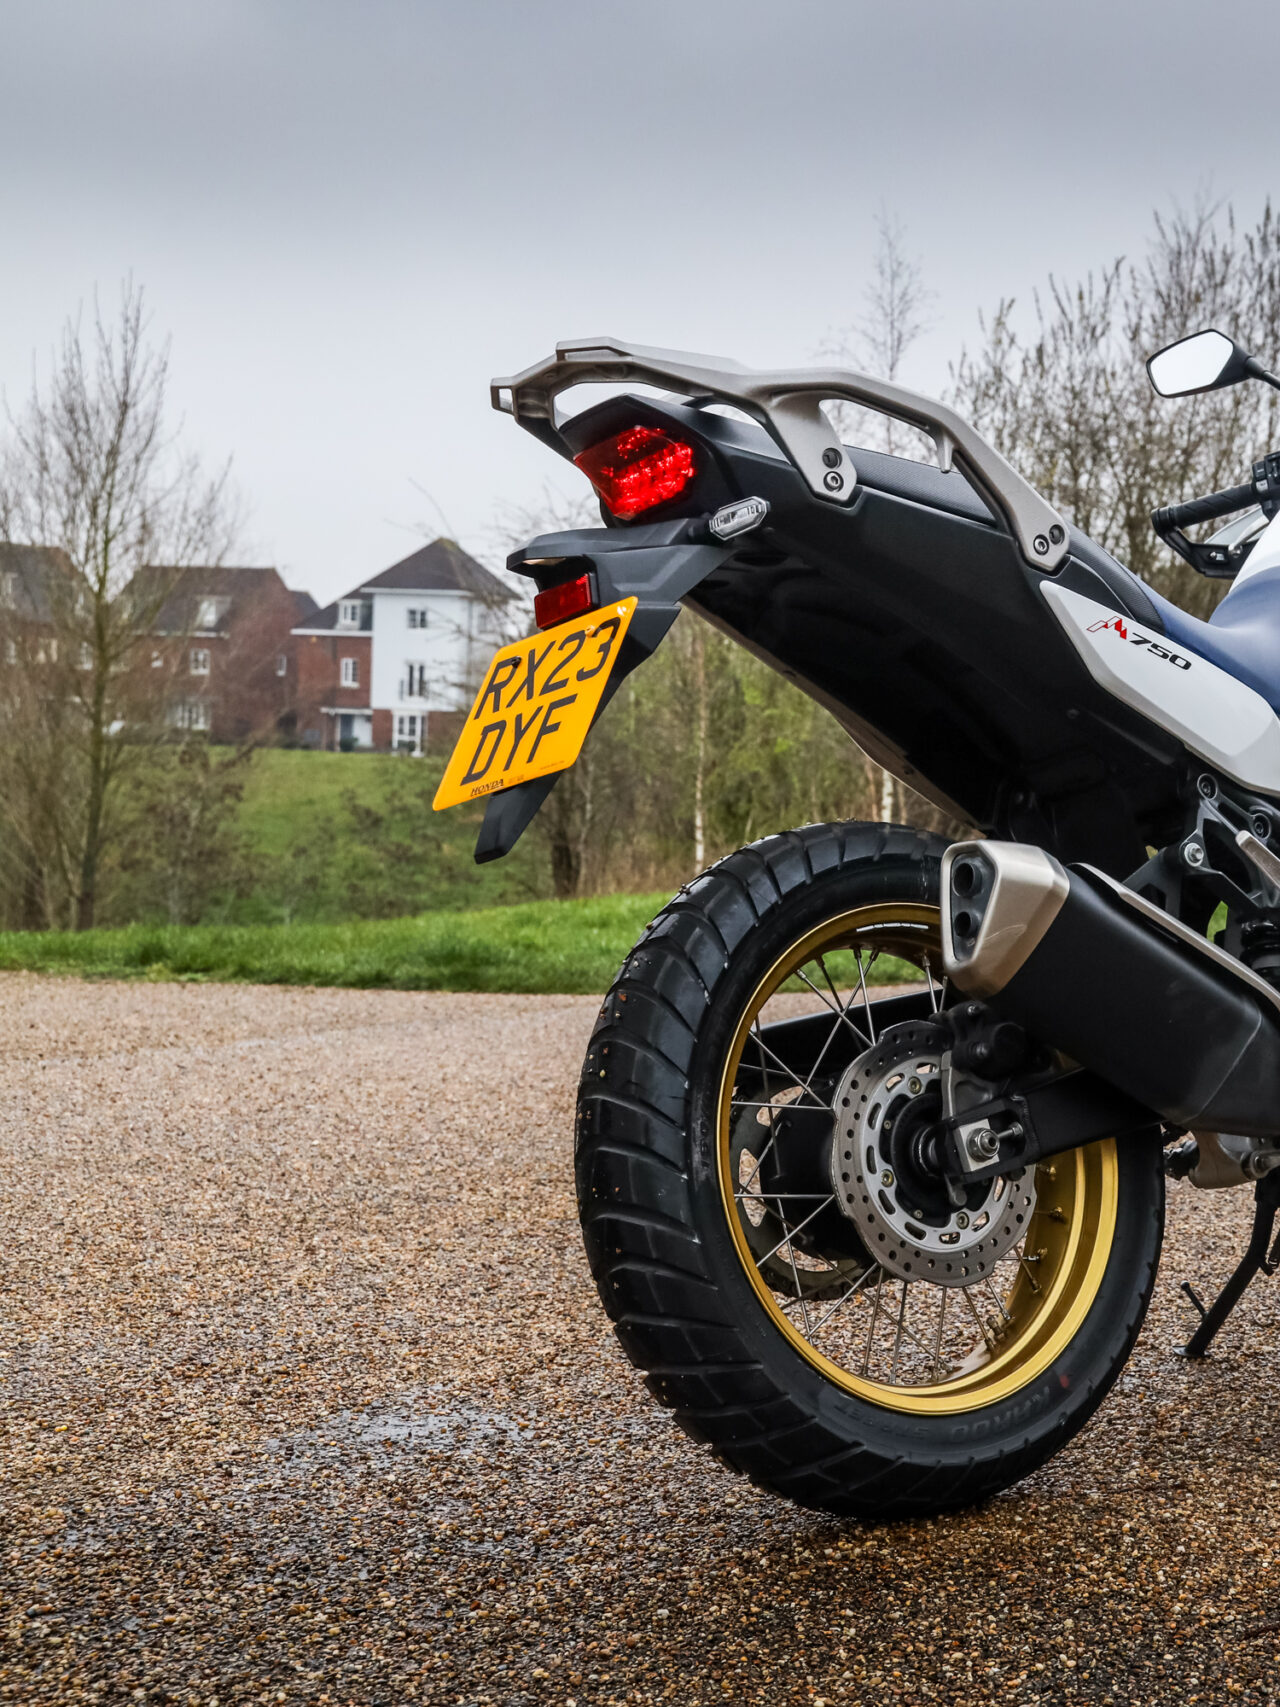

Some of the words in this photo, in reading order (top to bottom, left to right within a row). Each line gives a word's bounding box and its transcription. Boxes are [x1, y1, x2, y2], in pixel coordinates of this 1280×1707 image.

[474, 616, 621, 720] RX23
[1129, 632, 1192, 671] 750
[460, 693, 577, 786] DYF
[470, 778, 504, 798] HONDA
